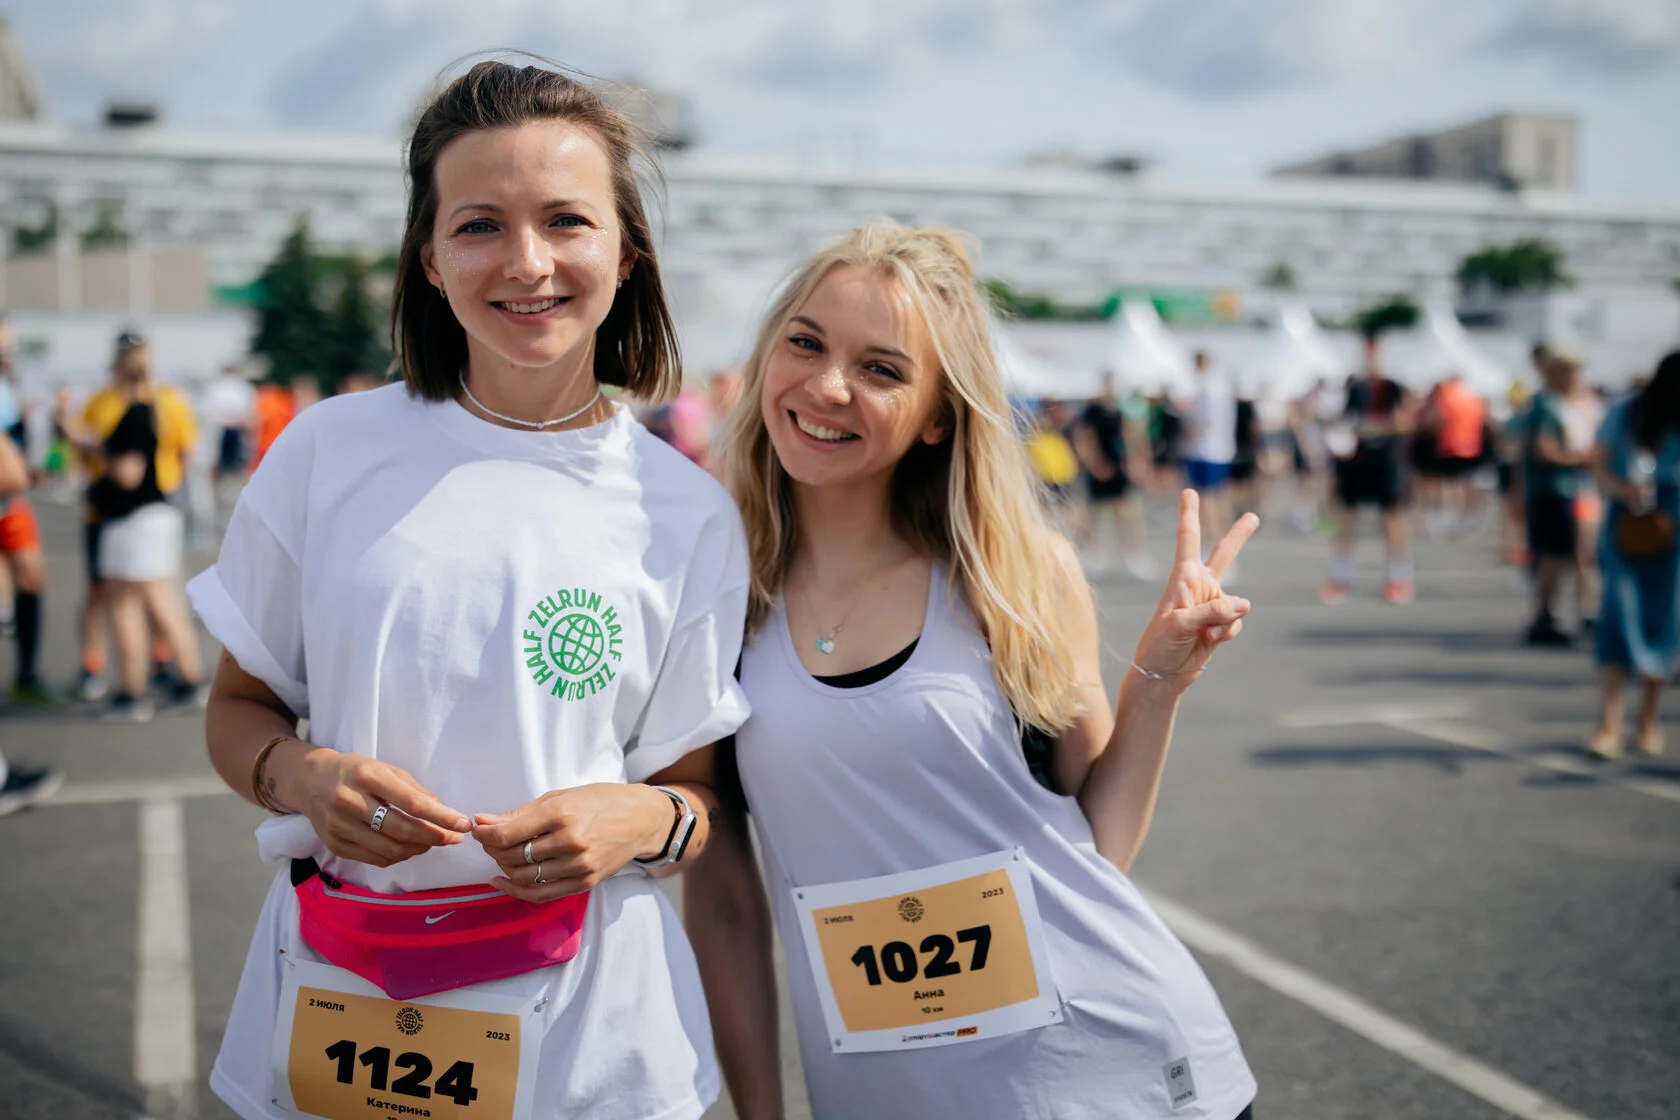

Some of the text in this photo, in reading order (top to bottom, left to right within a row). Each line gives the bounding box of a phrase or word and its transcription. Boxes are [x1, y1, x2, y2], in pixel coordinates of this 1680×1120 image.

[528, 588, 623, 662] ZELRUN HALF
[523, 629, 554, 686] HALF
[551, 662, 616, 701] ZELRUN
[982, 887, 1004, 898] 2023
[851, 924, 992, 986] 1027
[309, 998, 345, 1012] 2 ИЮЛЯ
[914, 989, 944, 1000] Анна
[486, 1030, 510, 1041] 2023
[325, 1040, 478, 1106] 1124
[367, 1096, 431, 1117] Катерина
